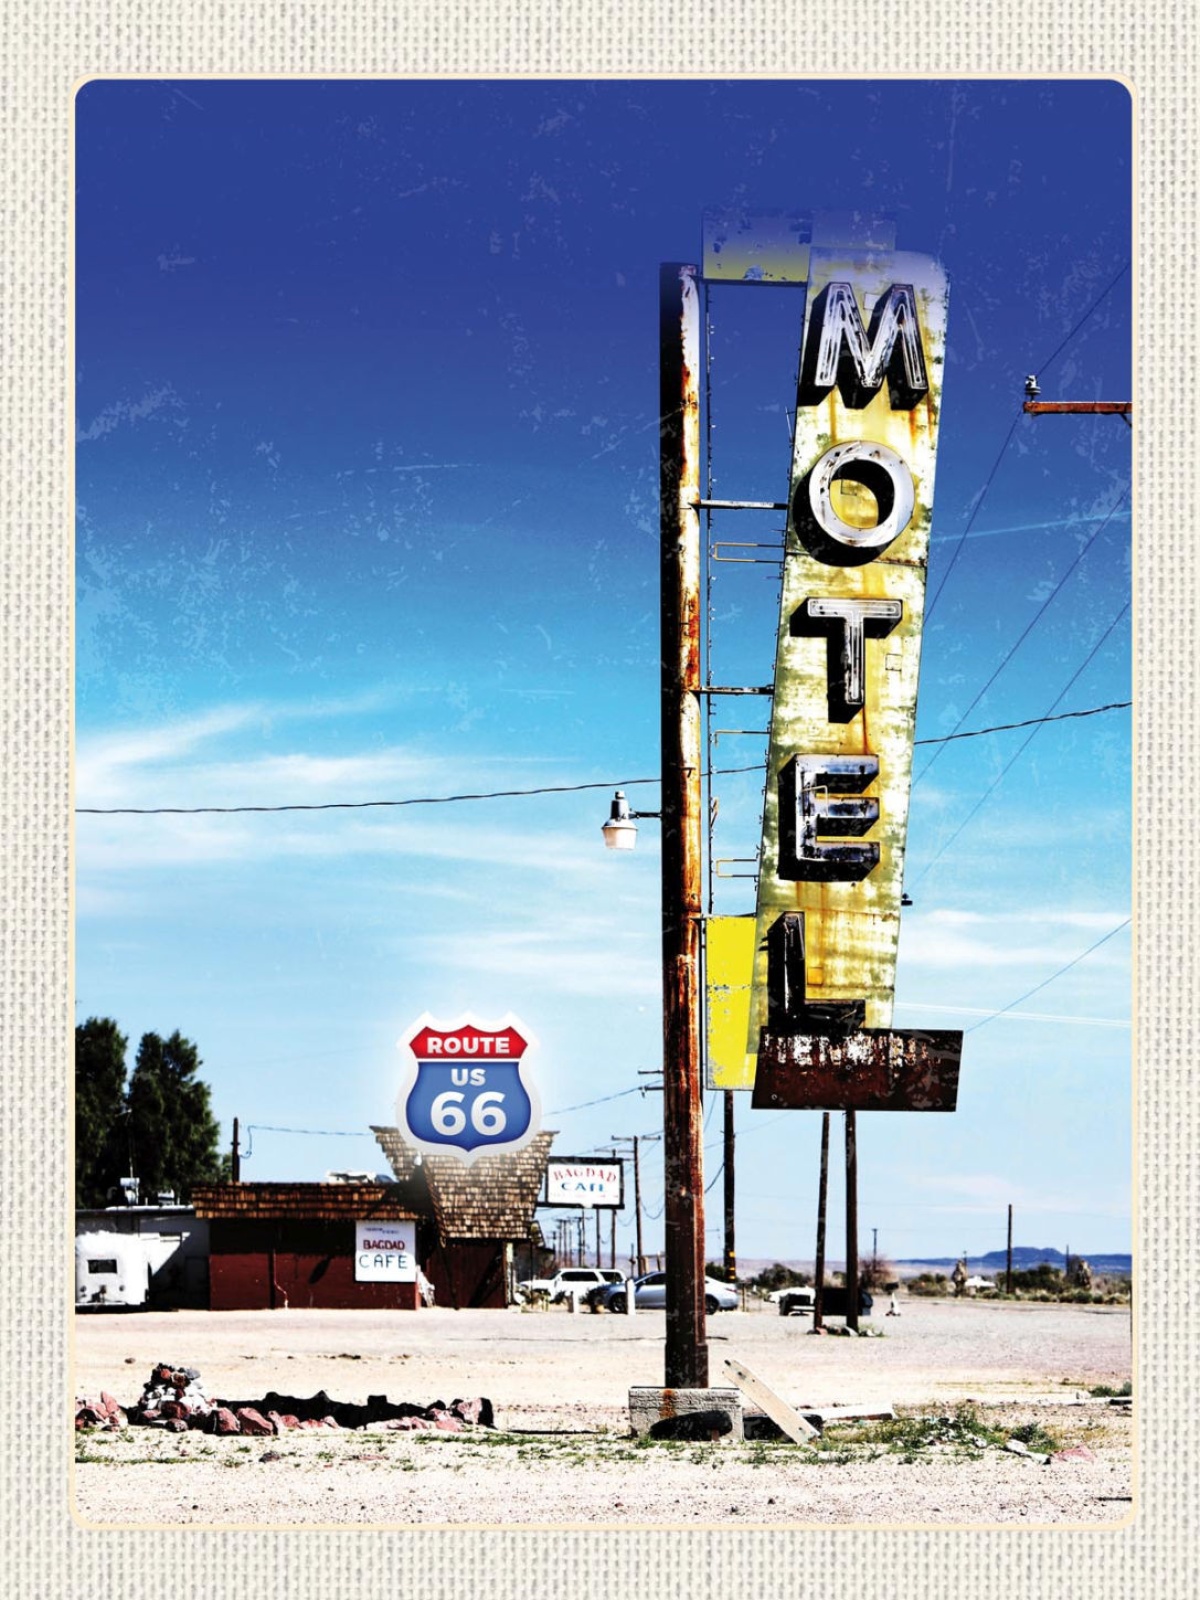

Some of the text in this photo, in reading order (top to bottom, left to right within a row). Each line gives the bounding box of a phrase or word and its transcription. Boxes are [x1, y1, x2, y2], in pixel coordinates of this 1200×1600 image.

[767, 281, 929, 1027] MOTEL
[553, 1167, 617, 1182] BAGDAD
[363, 1239, 405, 1250] BAGDAD
[359, 1254, 408, 1269] CAFE
